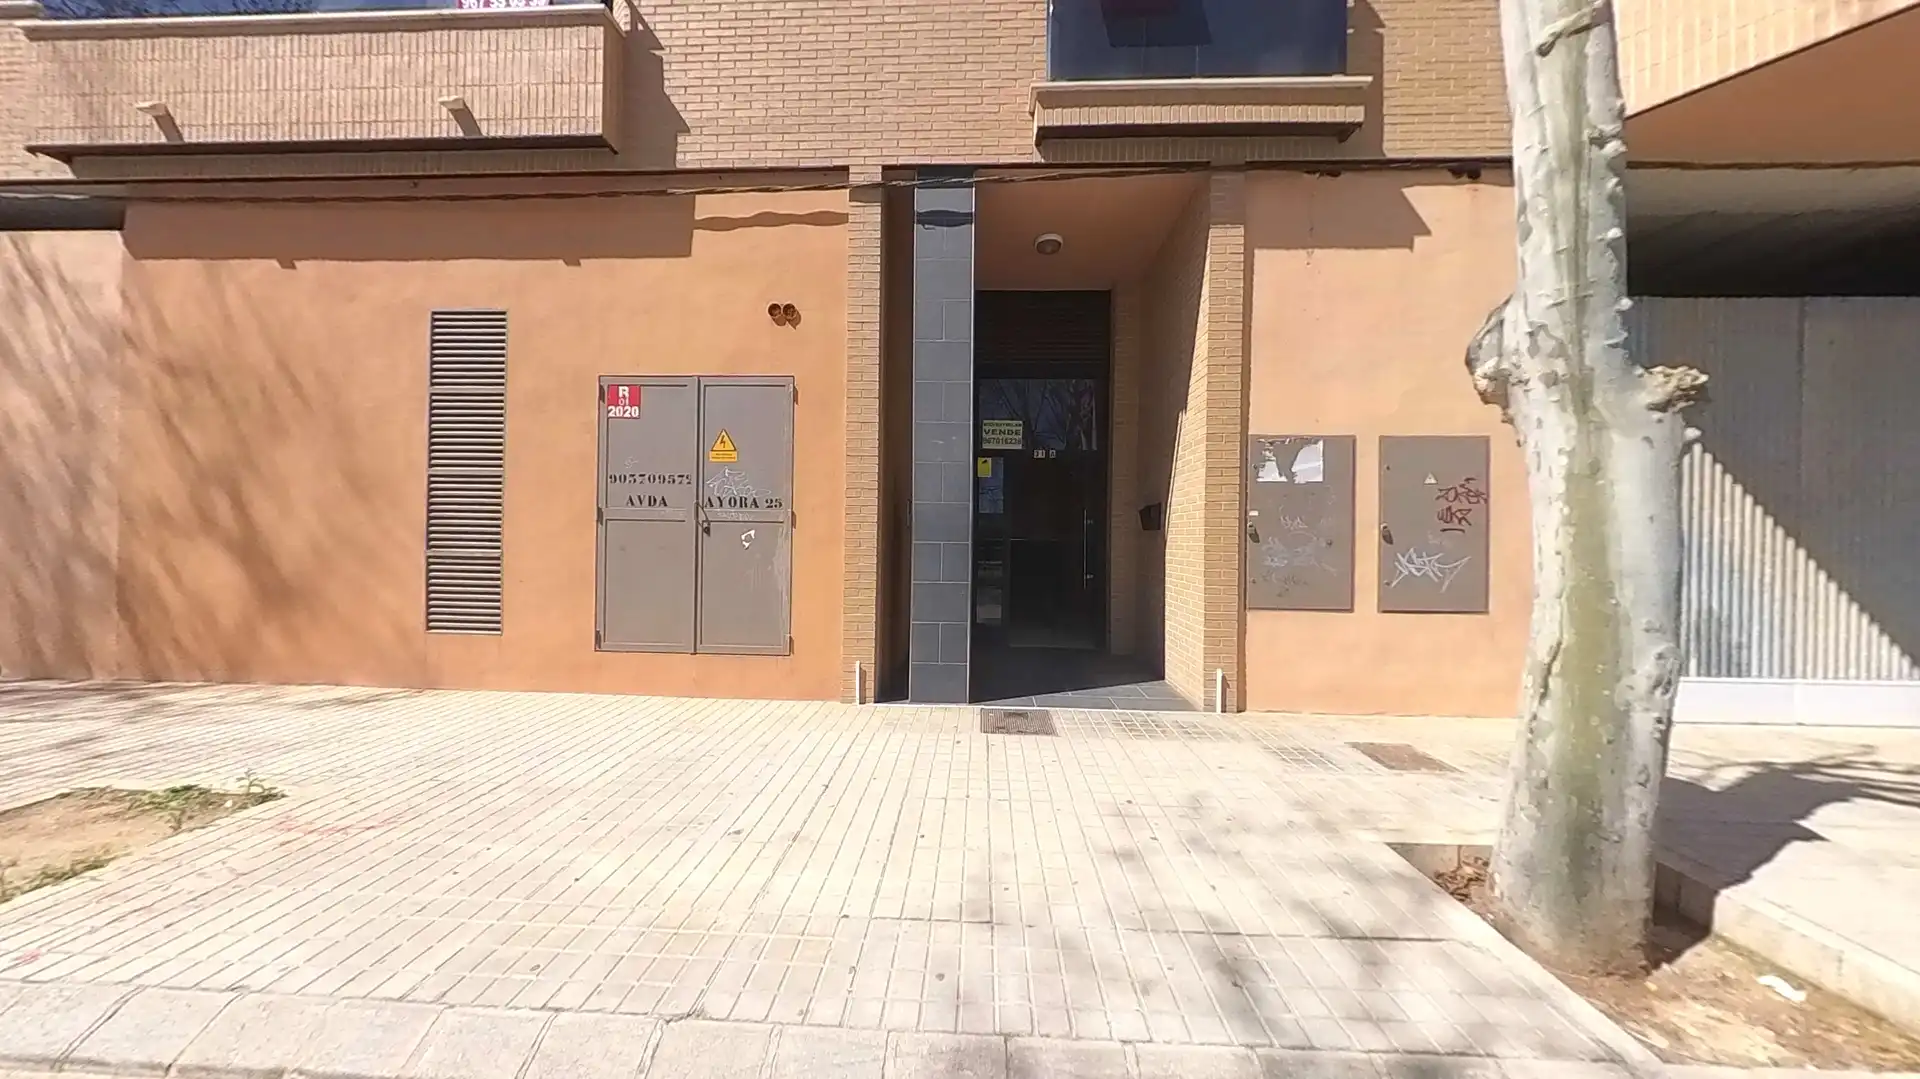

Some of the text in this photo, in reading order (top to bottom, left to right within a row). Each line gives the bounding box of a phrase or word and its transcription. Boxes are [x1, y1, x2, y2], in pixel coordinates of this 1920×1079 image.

[618, 386, 630, 398] R
[607, 406, 640, 418] 2020
[983, 428, 1021, 436] VENDE
[626, 495, 783, 509] AVDA AYORA 25
